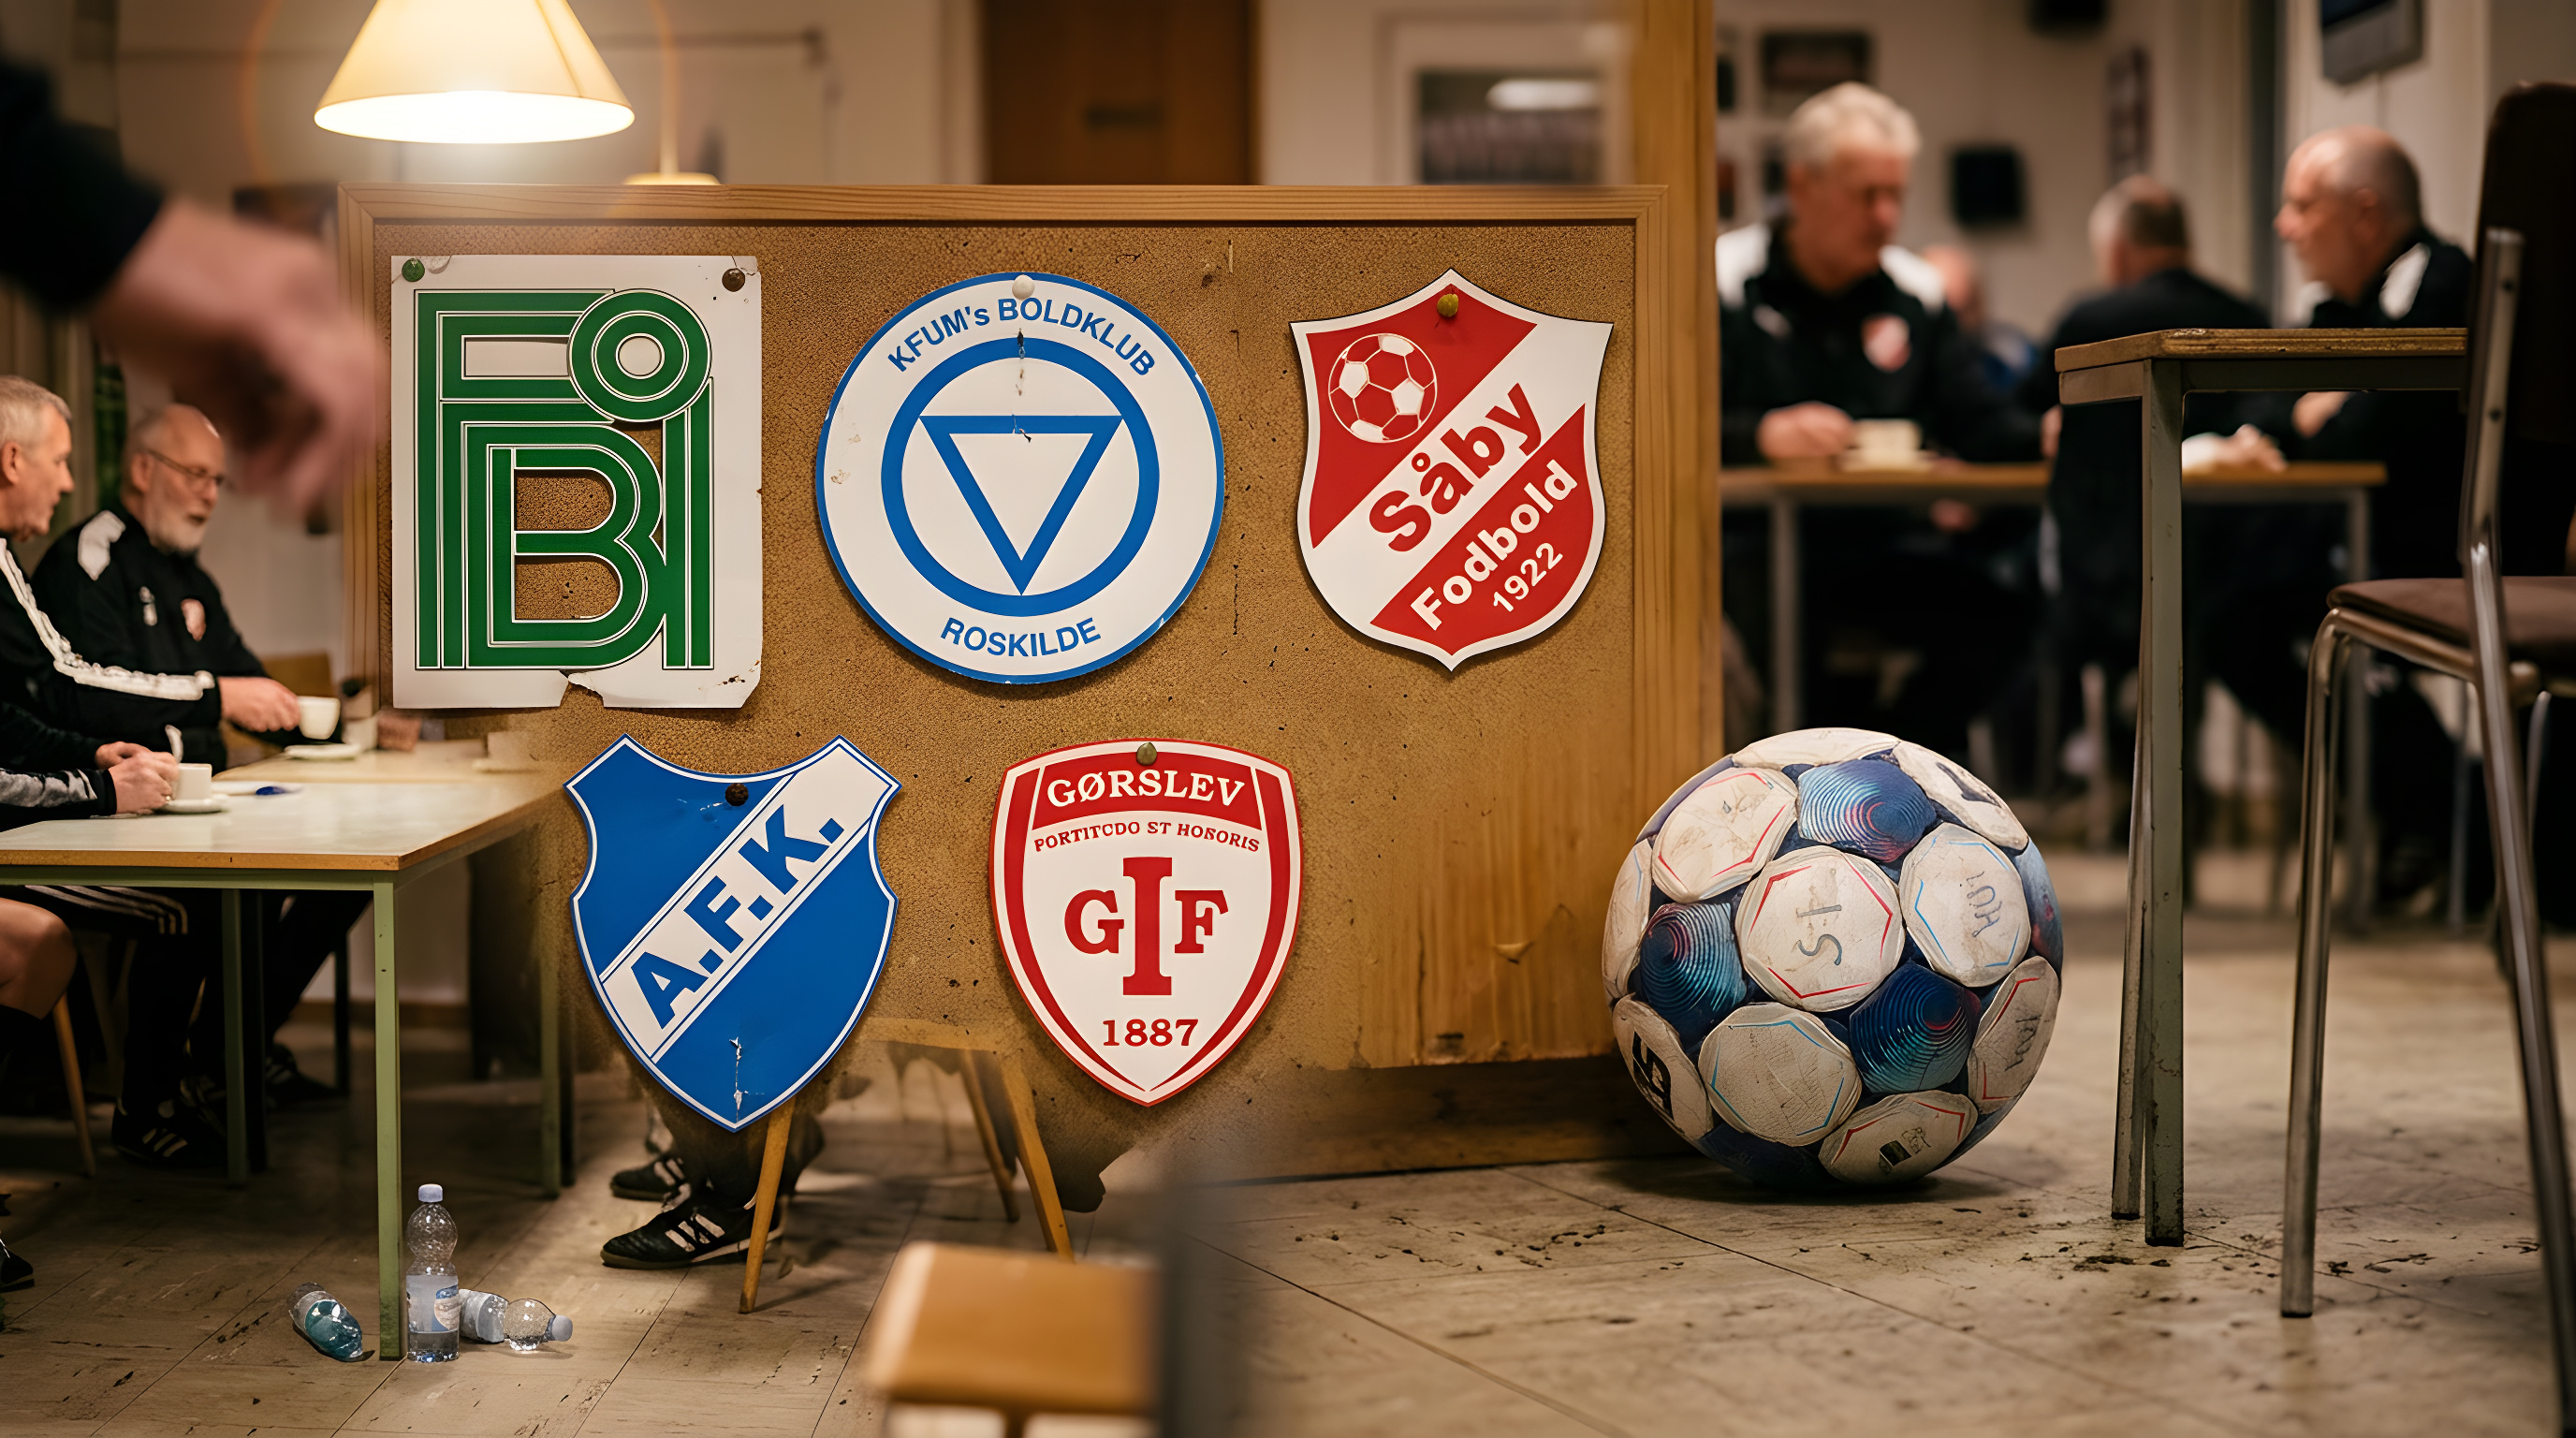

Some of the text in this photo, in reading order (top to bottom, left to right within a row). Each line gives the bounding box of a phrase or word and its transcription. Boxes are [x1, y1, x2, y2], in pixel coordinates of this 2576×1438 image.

[887, 297, 1156, 376] KFUM's BOLDKLUB
[1368, 382, 1542, 552] Såby
[1411, 460, 1578, 631] Fodbold
[1493, 542, 1564, 612] 1922
[941, 618, 1102, 658] ROSKILDE
[1046, 770, 1246, 807] GØRSLEV
[630, 803, 845, 1030] A.F.K.
[1103, 1019, 1199, 1047] 1887
